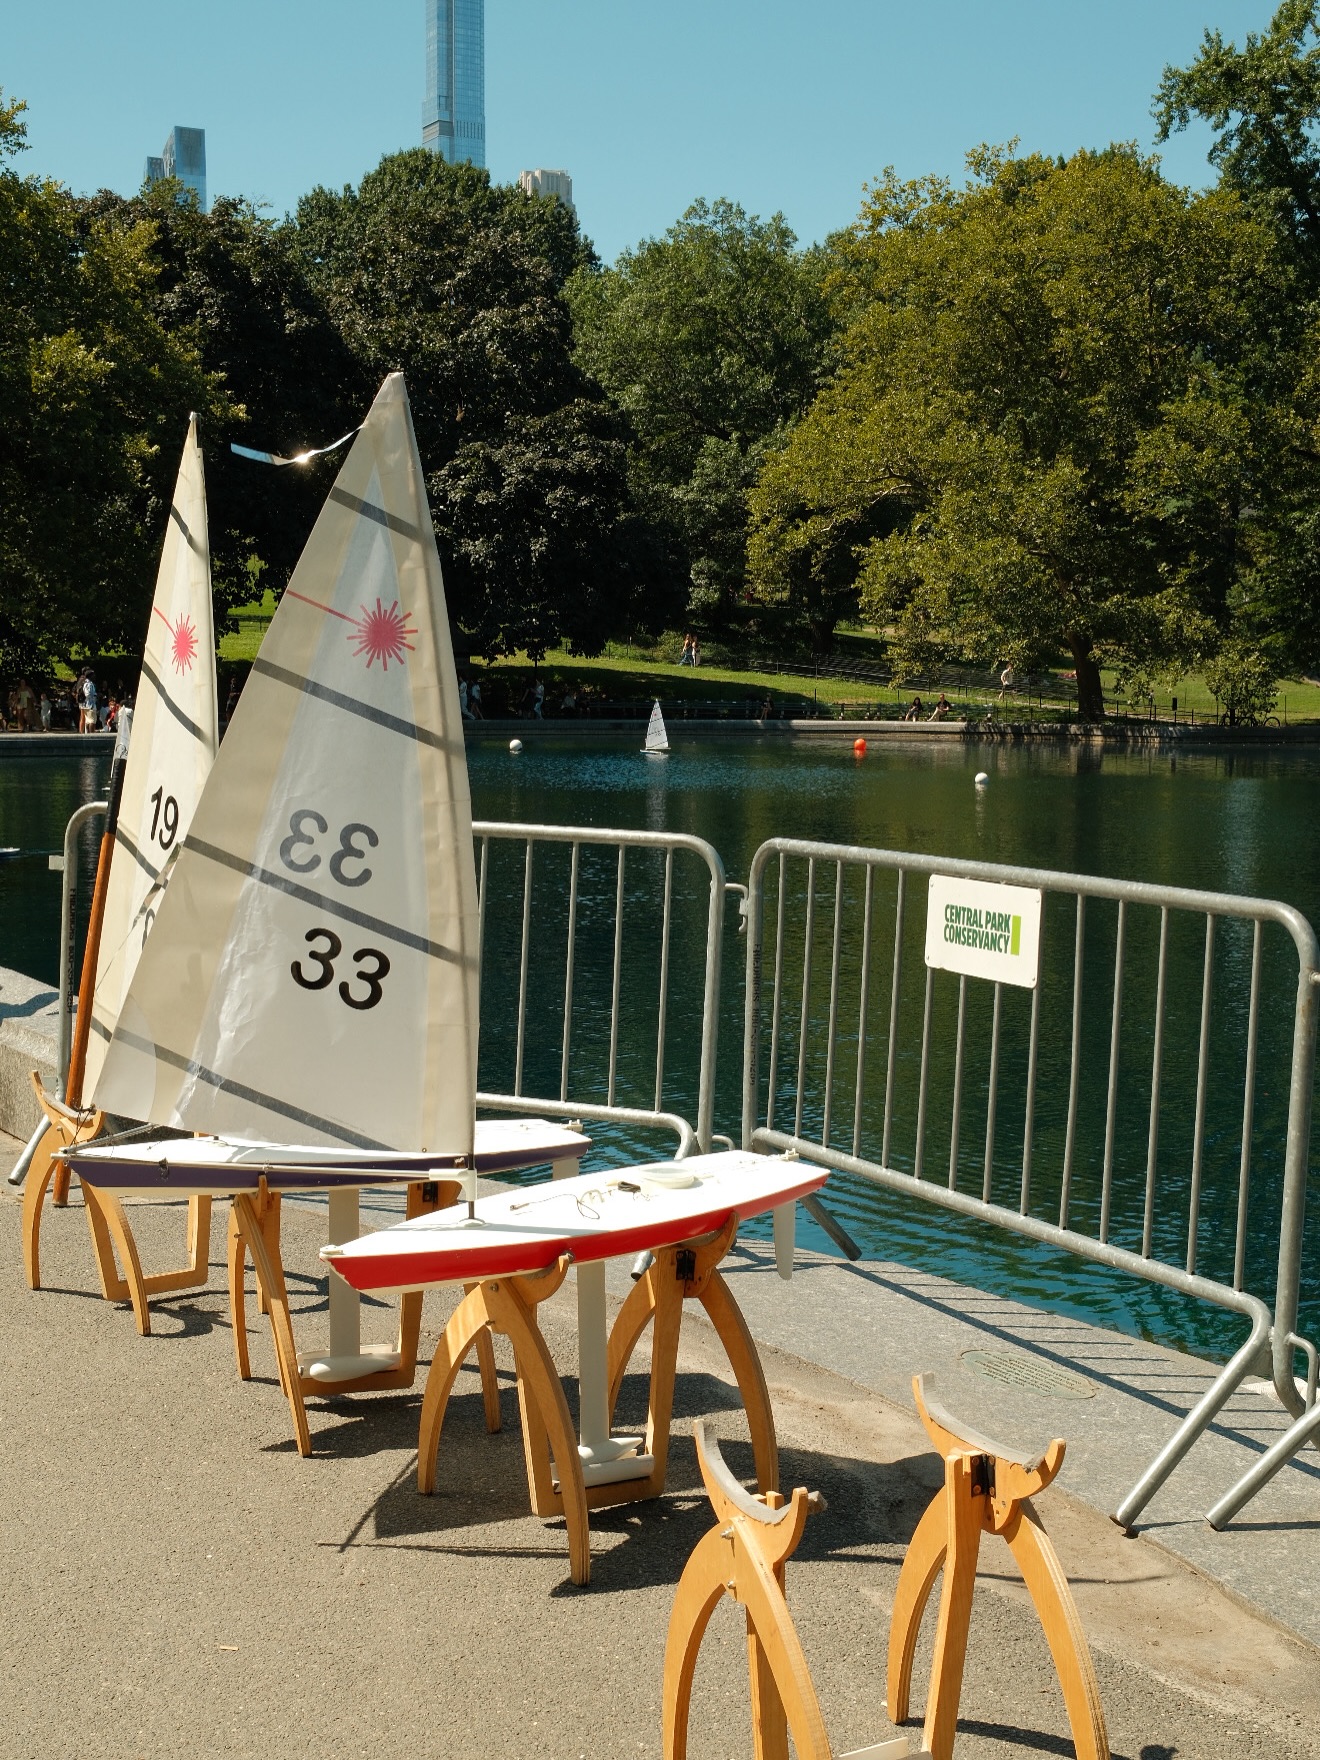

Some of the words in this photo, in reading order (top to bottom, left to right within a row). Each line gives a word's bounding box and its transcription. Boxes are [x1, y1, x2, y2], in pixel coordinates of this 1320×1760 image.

[151, 785, 179, 850] 19
[943, 924, 1010, 954] CONSERVANCY
[944, 904, 984, 929] CENTRAL
[985, 911, 1011, 934] PARK
[291, 928, 391, 1010] 33
